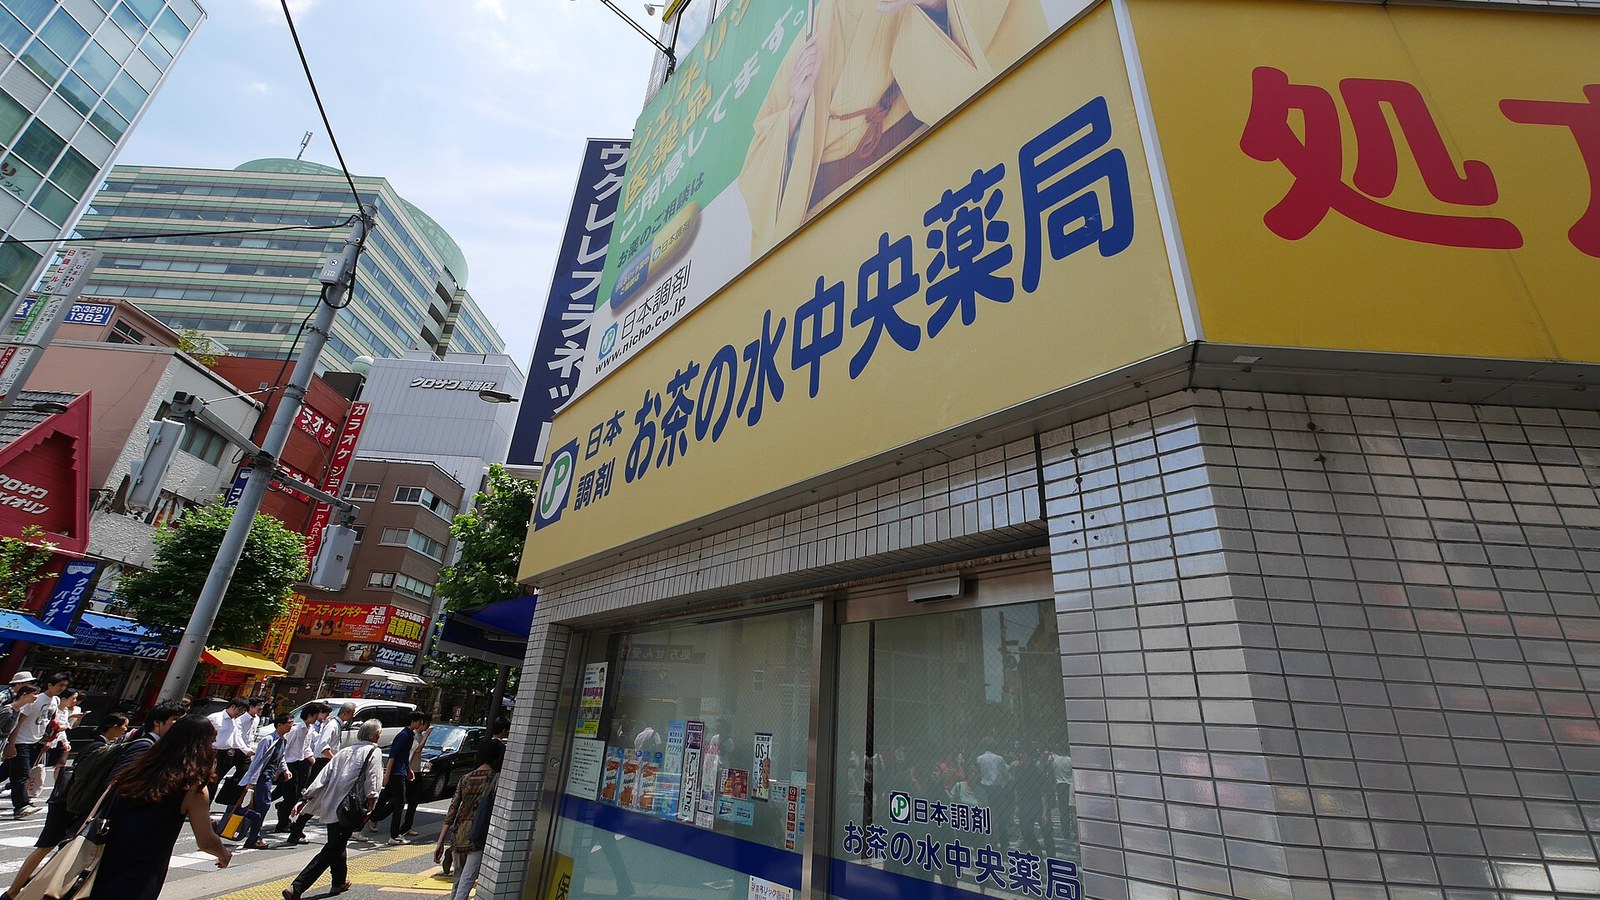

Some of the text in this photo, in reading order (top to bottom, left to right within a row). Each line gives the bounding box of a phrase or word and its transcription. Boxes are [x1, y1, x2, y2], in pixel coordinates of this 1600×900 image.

[623, 77, 712, 214] 医薬品
[69, 312, 104, 323] 1362
[621, 260, 692, 340] 日本調剤
[624, 96, 1135, 485] お茶の水中央薬局
[594, 294, 687, 375] www.nicho.co.jp
[295, 404, 336, 439] ラオケ
[331, 404, 368, 461] カラオケ
[585, 409, 626, 462] 日本
[573, 456, 616, 512] 調剤
[62, 577, 90, 614] クロサワ
[914, 799, 992, 834] 日本調剤
[843, 821, 1083, 900] お茶の水中央薬局
